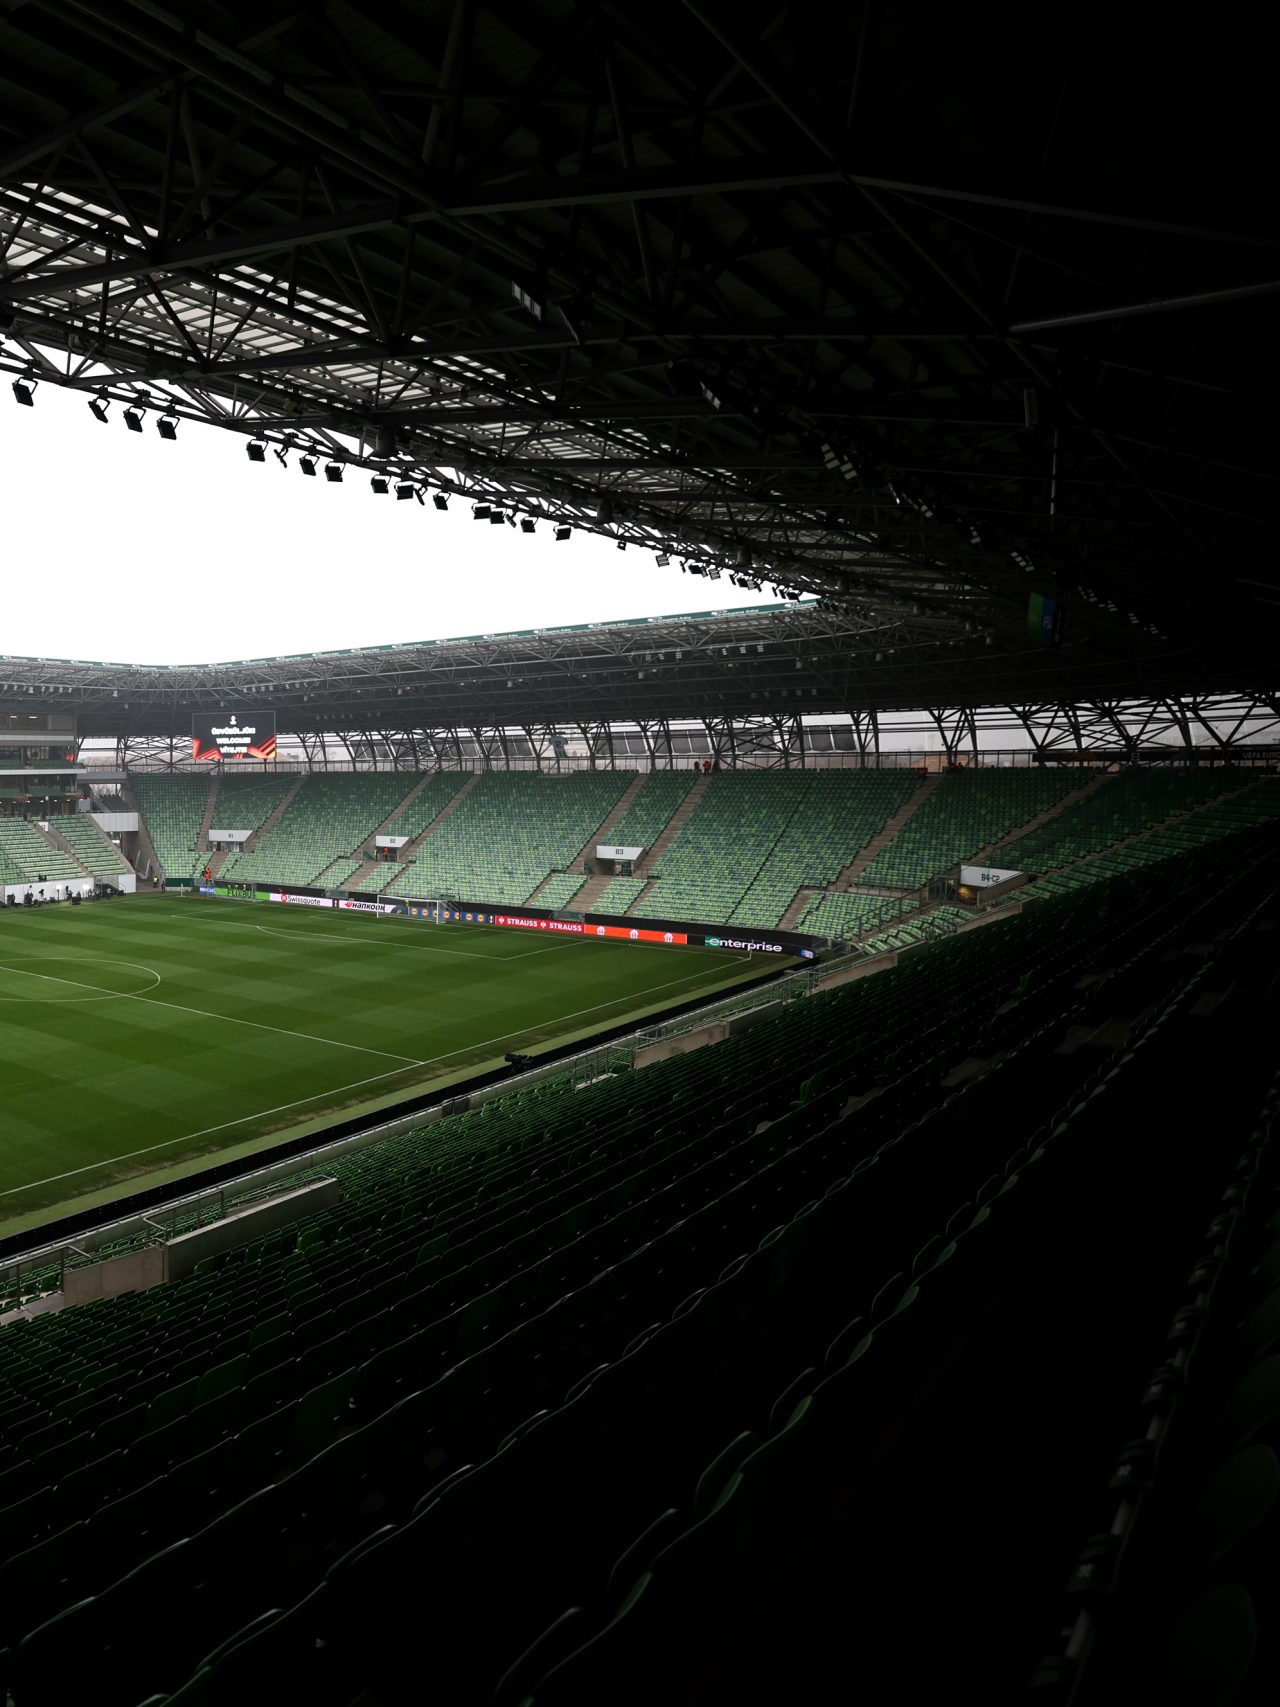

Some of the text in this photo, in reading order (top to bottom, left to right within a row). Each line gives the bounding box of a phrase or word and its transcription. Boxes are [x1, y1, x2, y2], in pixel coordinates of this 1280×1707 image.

[981, 873, 1001, 883] B4-C2
[287, 895, 321, 905] Swissquote
[506, 918, 583, 932] STRAUSS STRAUSS
[709, 938, 783, 952] enterprise
